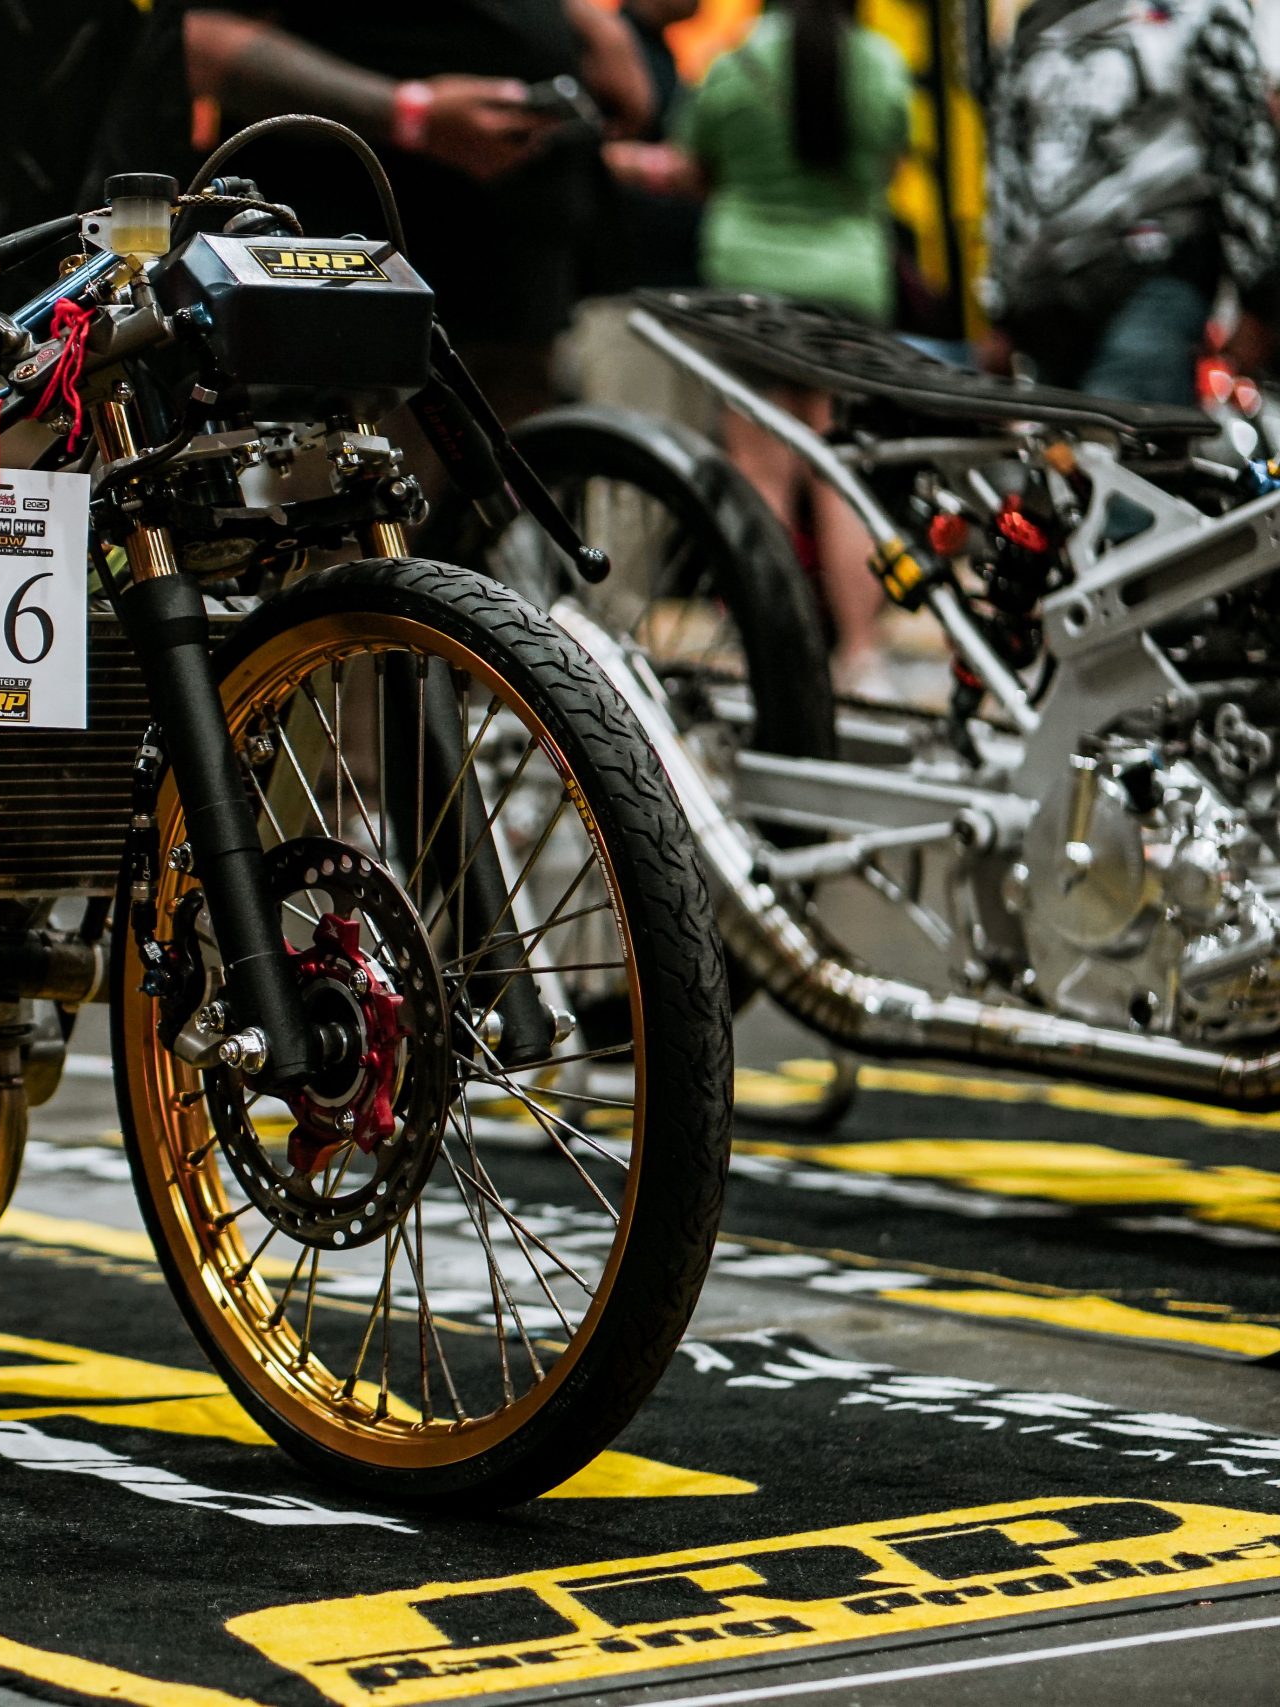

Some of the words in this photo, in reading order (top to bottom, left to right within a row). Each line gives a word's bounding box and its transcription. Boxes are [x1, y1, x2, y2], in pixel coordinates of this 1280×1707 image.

[267, 252, 365, 269] JRP
[273, 267, 319, 275] Racing
[25, 501, 46, 509] 2025
[15, 520, 44, 535] BIKE
[16, 548, 52, 556] CENTER
[563, 777, 595, 831] JRP
[308, 1501, 1185, 1666] JRP
[347, 1614, 816, 1695] Racing
